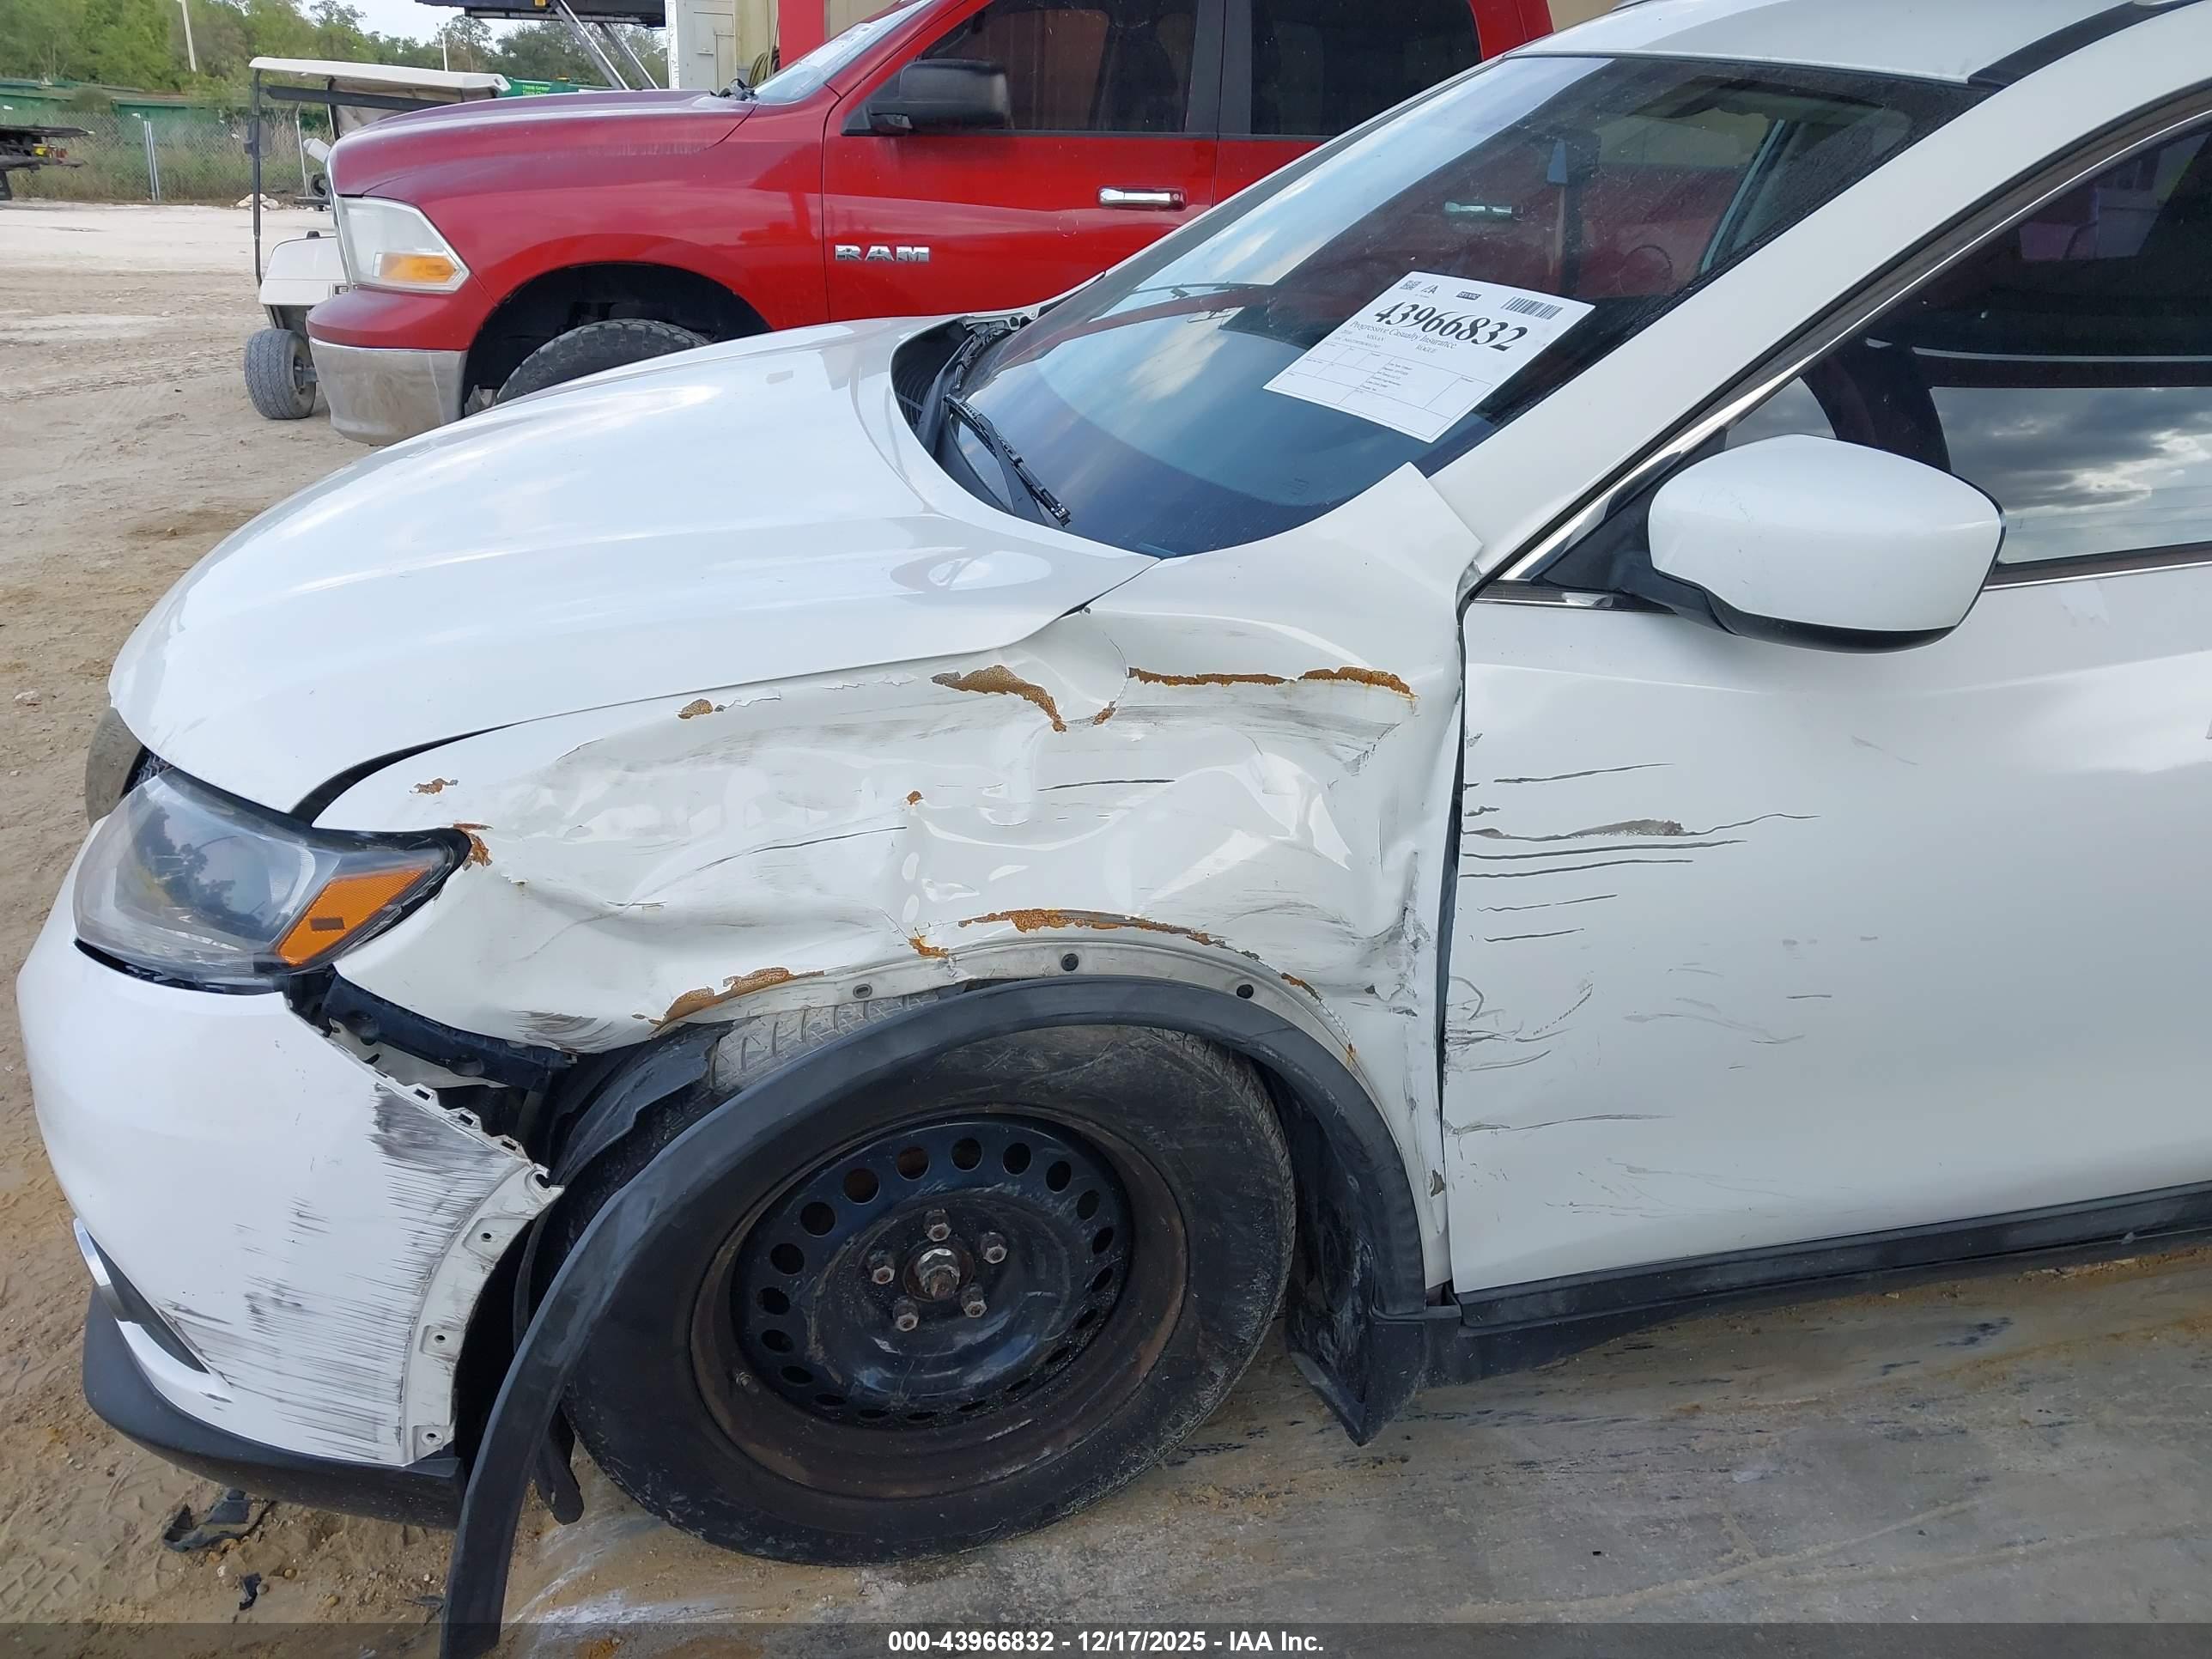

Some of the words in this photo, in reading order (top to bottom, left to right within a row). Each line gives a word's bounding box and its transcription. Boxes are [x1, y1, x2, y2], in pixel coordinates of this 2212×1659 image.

[835, 244, 930, 262] RAM
[1350, 320, 1389, 334] Progressive
[1389, 328, 1419, 342] Casualty
[1419, 335, 1457, 349] Insurance
[1374, 301, 1528, 352] 43966832
